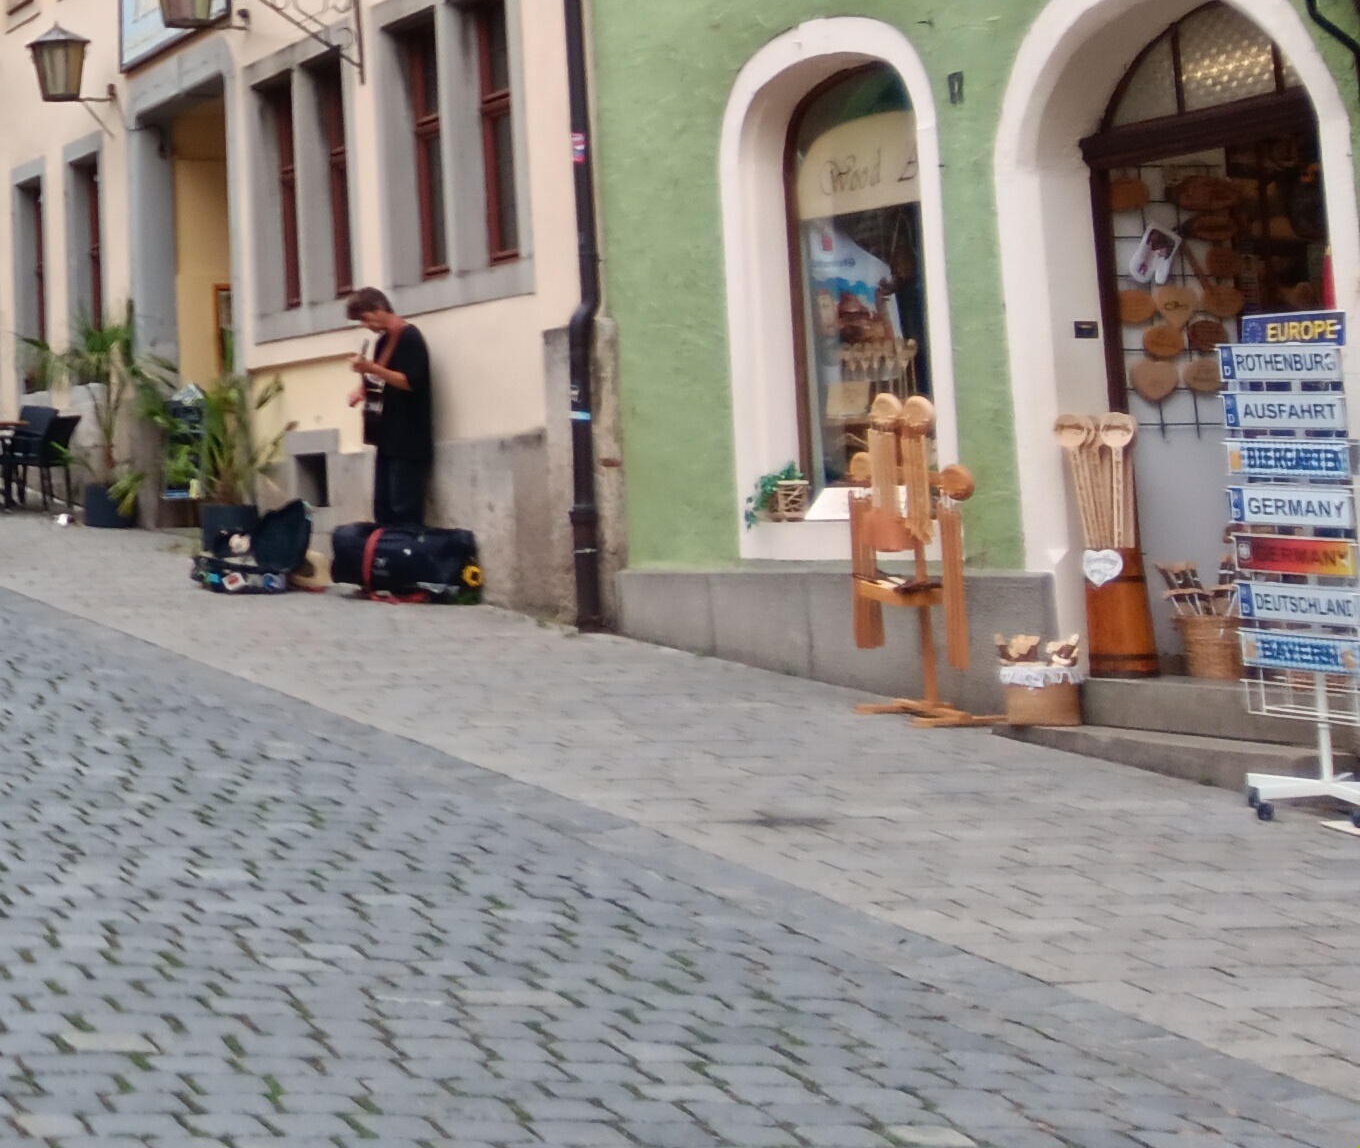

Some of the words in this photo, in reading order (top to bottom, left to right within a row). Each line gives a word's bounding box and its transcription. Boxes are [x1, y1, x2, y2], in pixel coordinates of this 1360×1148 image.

[1266, 320, 1338, 342] EUROPE
[1235, 353, 1336, 372] ROTHENBURG
[1243, 403, 1337, 419] AUSFAHRT
[1248, 497, 1344, 519] GERMANY
[1254, 592, 1354, 618] DEUTSCHLAND
